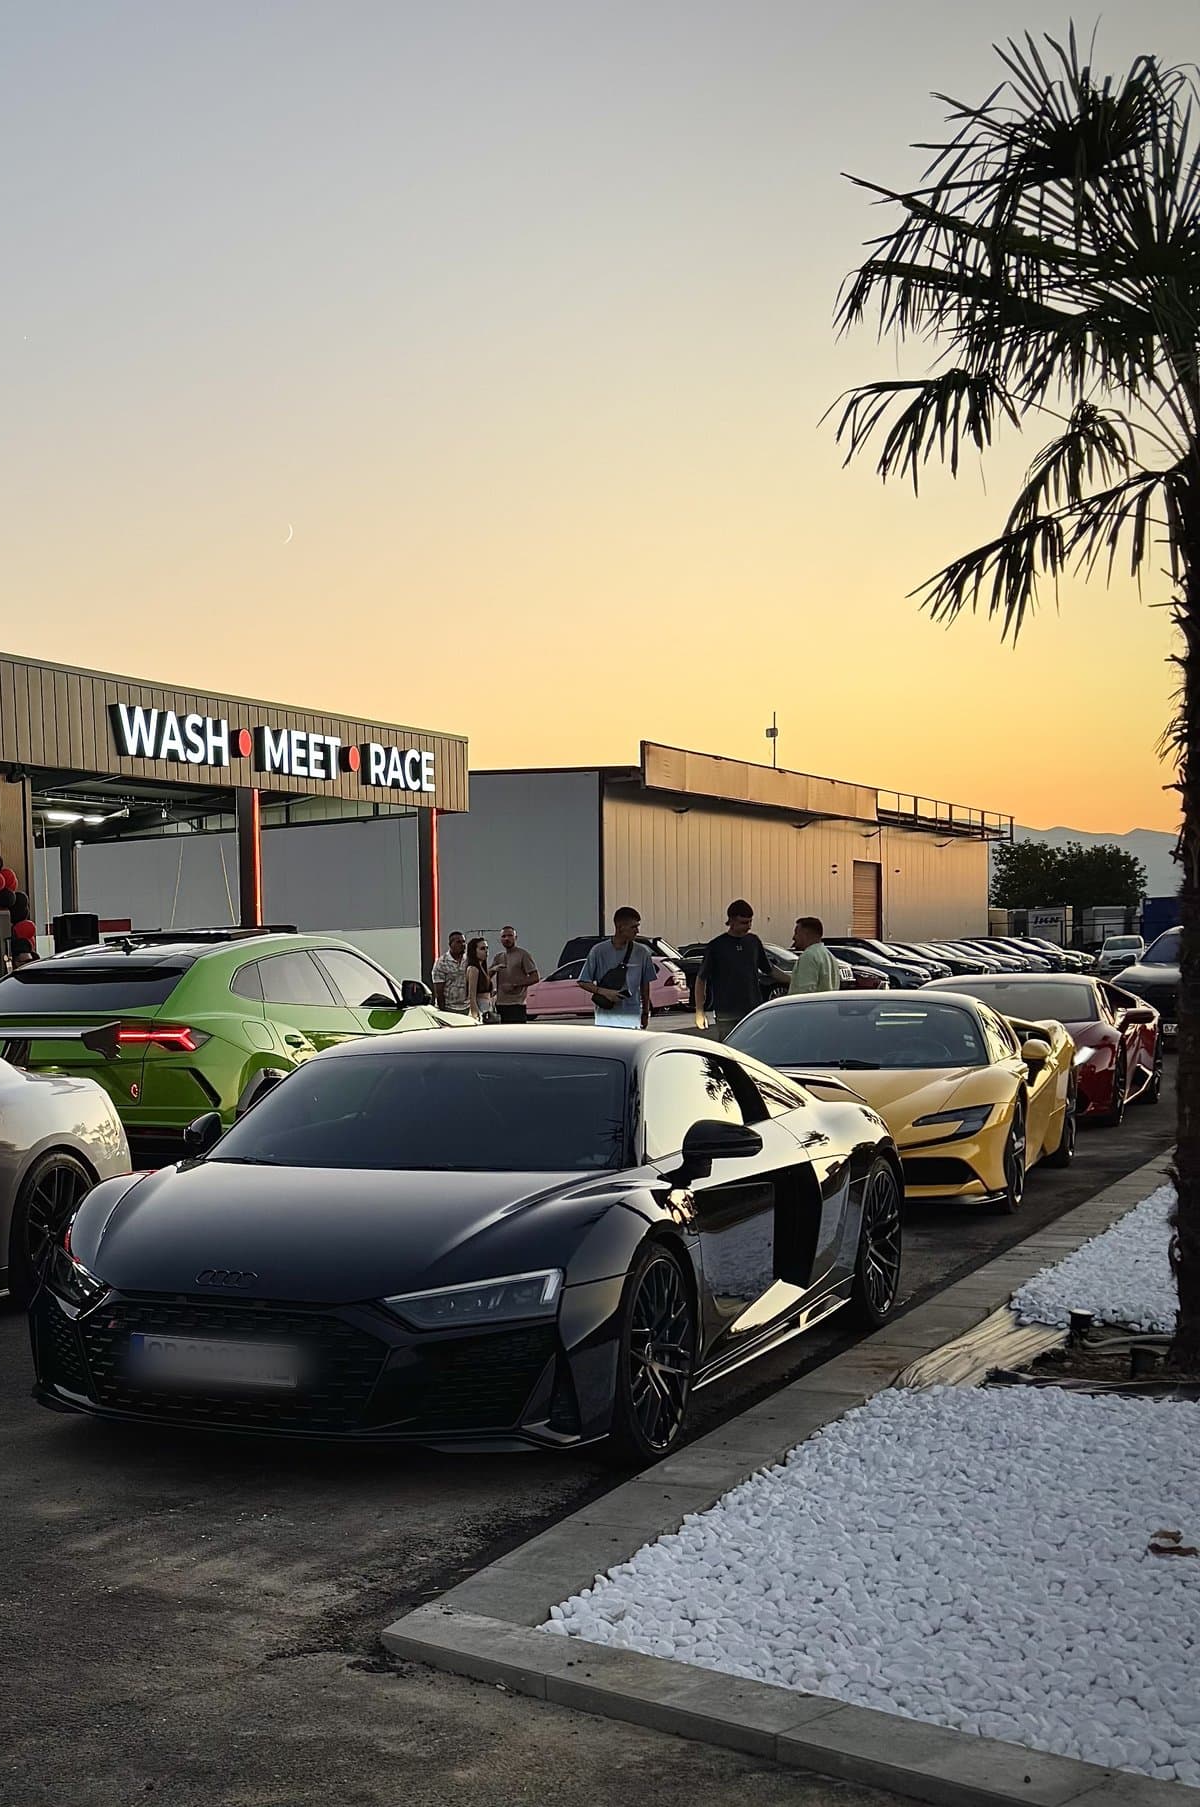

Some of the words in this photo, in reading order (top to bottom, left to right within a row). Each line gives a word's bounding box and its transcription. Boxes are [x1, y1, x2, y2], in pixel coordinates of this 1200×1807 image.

[119, 703, 229, 766] WASH
[264, 726, 341, 780] MEET
[369, 742, 435, 792] RACE
